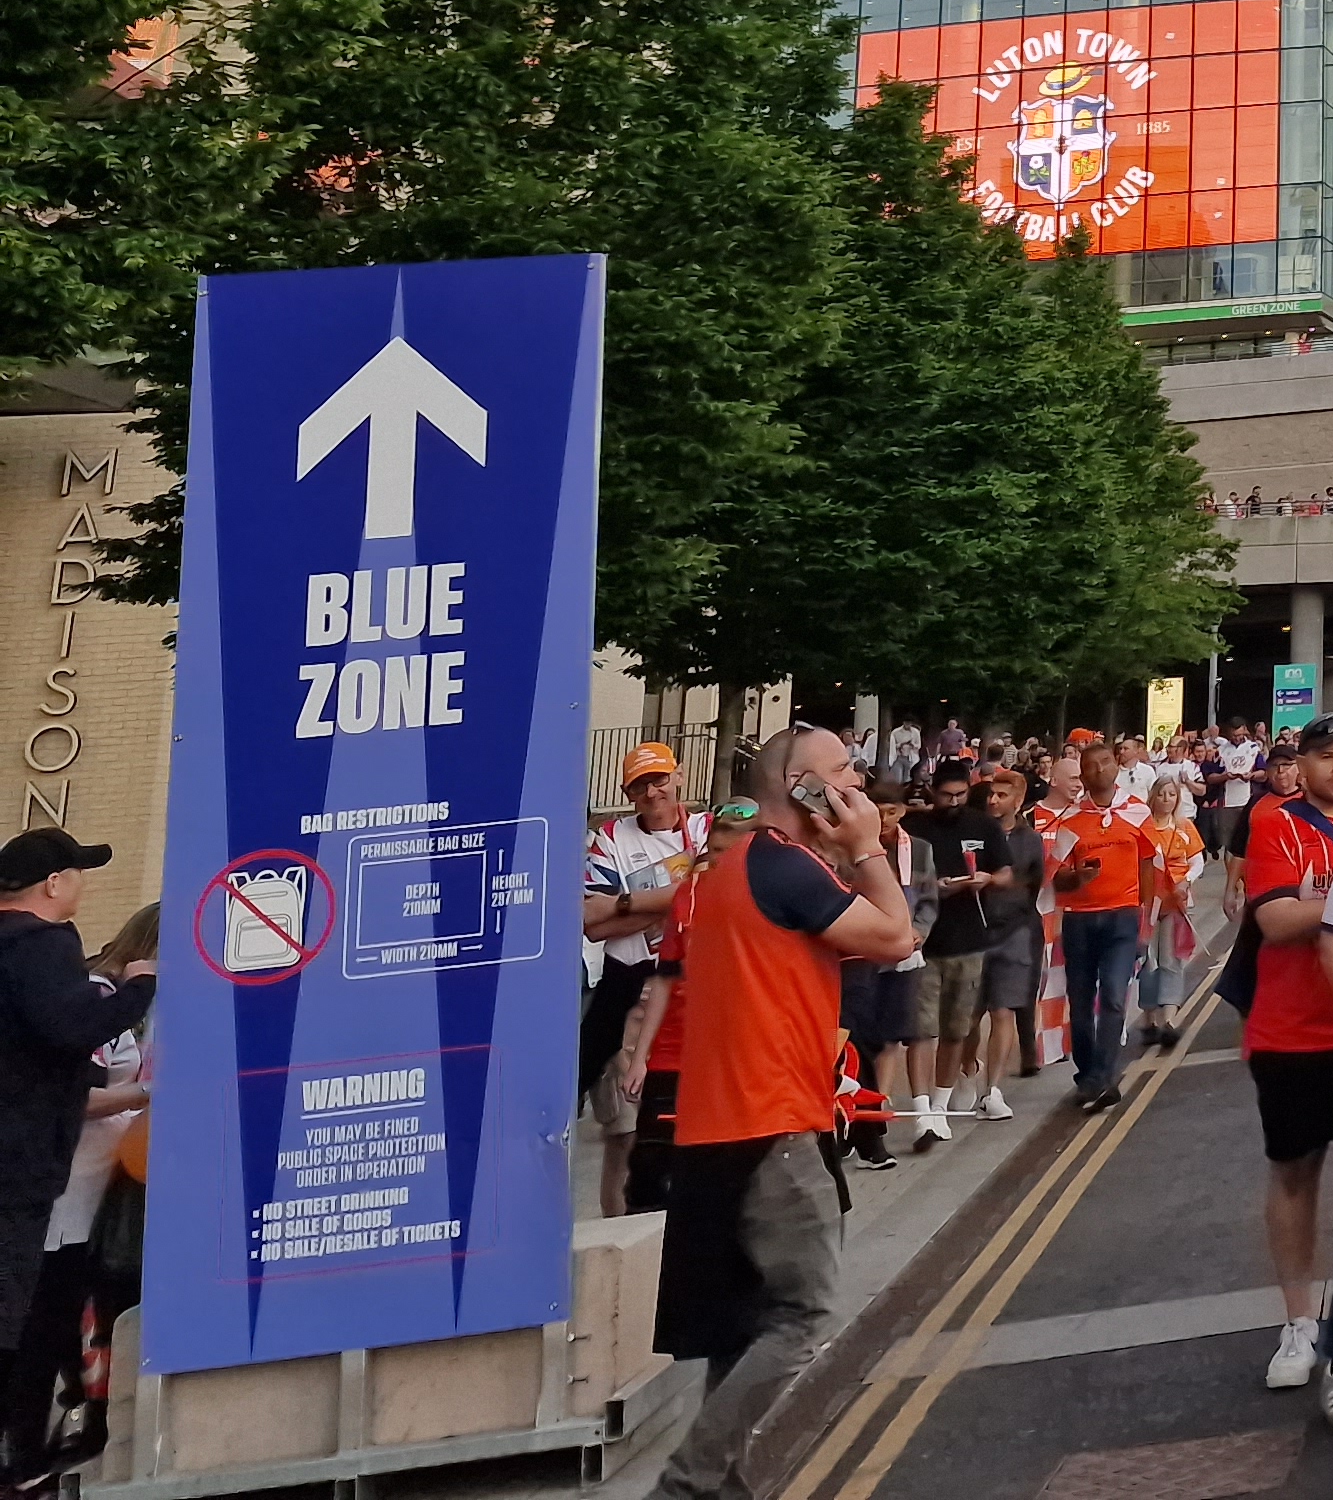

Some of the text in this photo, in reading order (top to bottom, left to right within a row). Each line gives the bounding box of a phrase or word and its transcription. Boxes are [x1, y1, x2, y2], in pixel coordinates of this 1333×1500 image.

[972, 28, 1158, 103] LUTON TOWN
[956, 135, 984, 152] EST
[1090, 165, 1155, 228] CLUB
[1232, 301, 1301, 316] GREEN ZONE
[305, 562, 466, 648] BLUE
[20, 446, 119, 833] MADISON
[295, 650, 466, 739] ZONE
[300, 801, 450, 834] BAG RESTRICTIONS
[360, 832, 486, 860] PERMISSABLE BAG SIZE
[405, 882, 441, 900] DEPTH
[490, 888, 534, 908] 297 MM
[491, 872, 530, 891] HEIGHT
[402, 898, 442, 917] 210MM
[380, 941, 459, 965] WIDTH 210MM
[302, 1067, 426, 1112] WARNING
[305, 1116, 419, 1146] YOU MAY BE FINED
[277, 1132, 447, 1171] PUBLIC SPACE PROTECTION
[296, 1155, 426, 1188] ORDER IN OPERATION
[261, 1186, 409, 1221] NO STREET DRINKING
[259, 1219, 461, 1262] NO SALE/RESALE OF TICKETS
[260, 1208, 393, 1241] NO SALE OF GOODS
